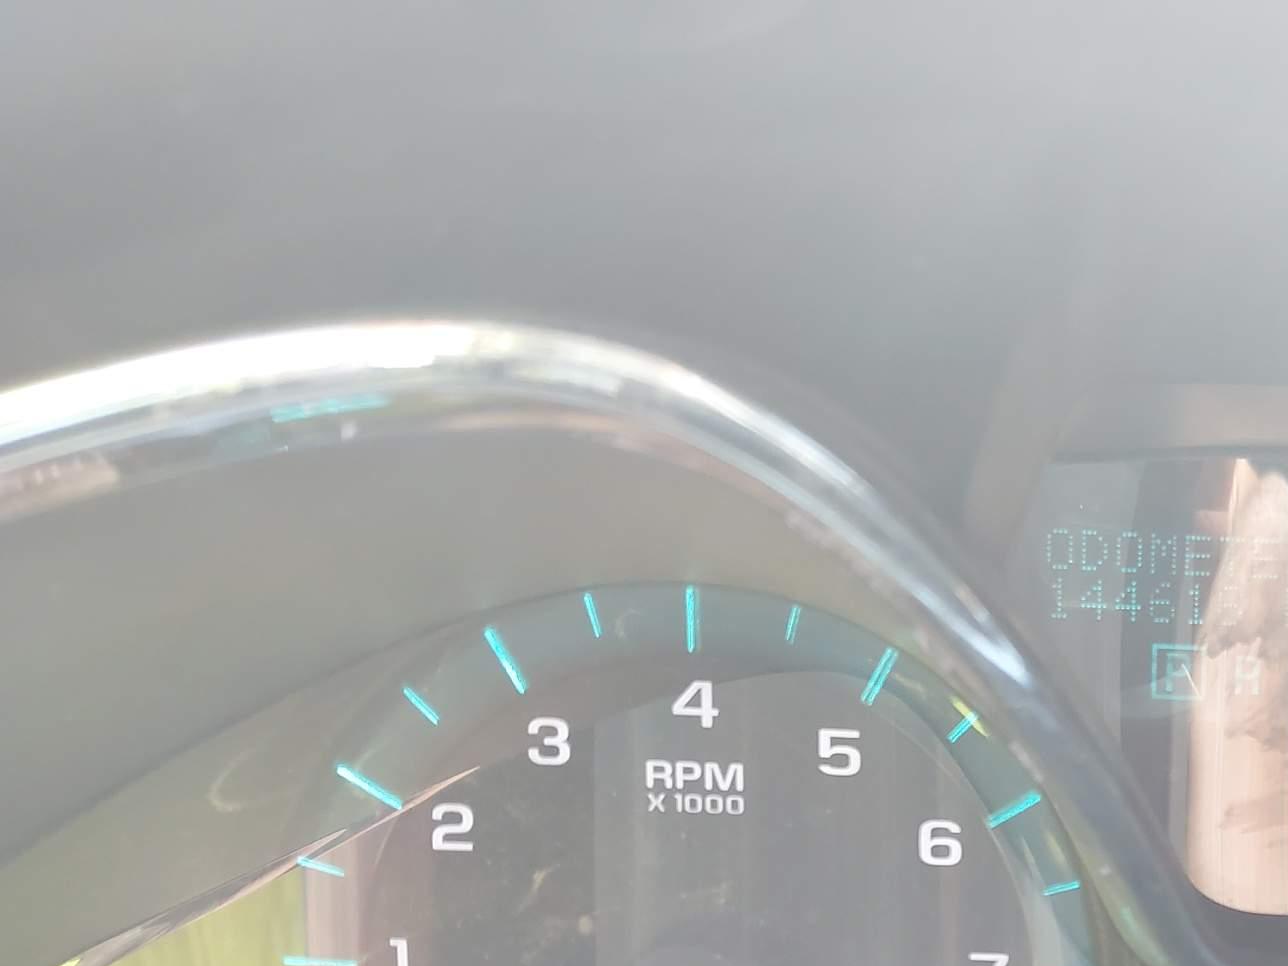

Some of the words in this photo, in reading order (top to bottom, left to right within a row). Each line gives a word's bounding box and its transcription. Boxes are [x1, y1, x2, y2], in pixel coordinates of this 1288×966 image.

[1234, 654, 1262, 697] R
[671, 680, 719, 728] 4
[527, 717, 572, 766] 3
[817, 728, 862, 776] 5
[645, 760, 745, 792] RPM
[430, 803, 475, 852] 2
[674, 794, 745, 816] 1000
[918, 819, 963, 867] 6
